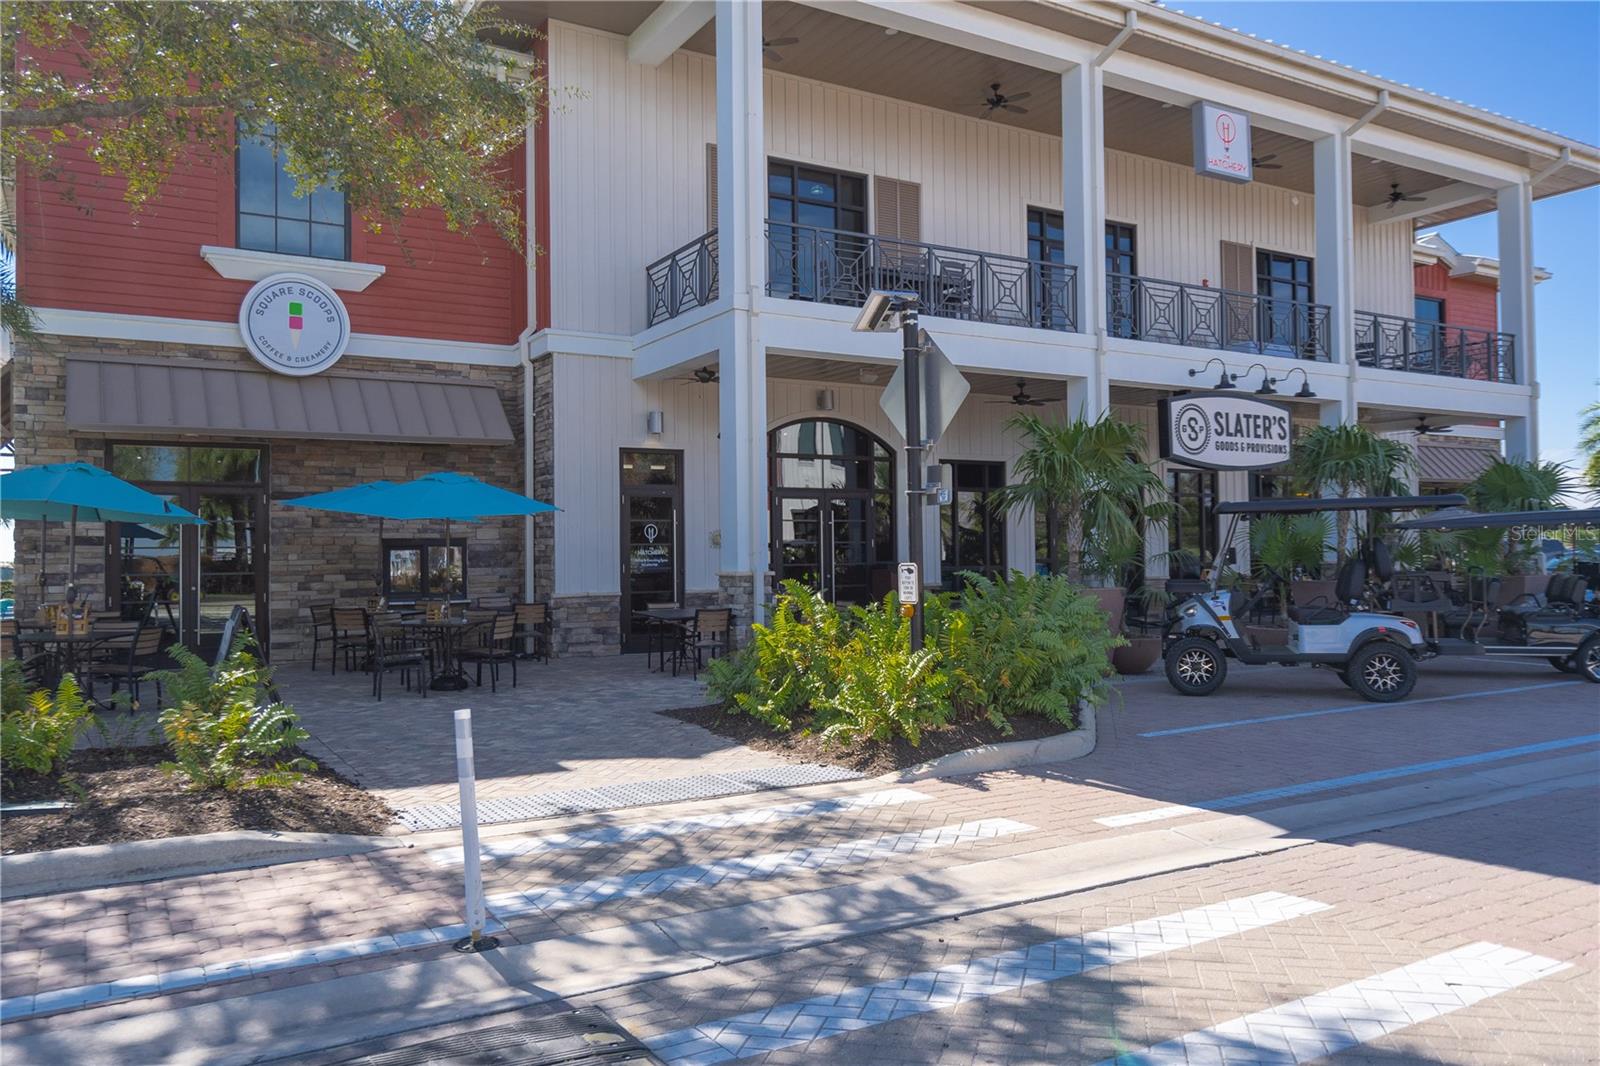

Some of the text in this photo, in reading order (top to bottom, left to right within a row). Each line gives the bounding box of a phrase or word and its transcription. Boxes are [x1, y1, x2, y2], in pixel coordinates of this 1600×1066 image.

[1208, 159, 1247, 172] HATCHERY
[255, 286, 335, 323] SQUARE SCOOPS
[258, 335, 283, 359] COFFEE
[294, 341, 332, 363] CREAMERY
[1213, 411, 1287, 440] SLATER'S
[1215, 440, 1287, 454] GOODS & PROVISIONS
